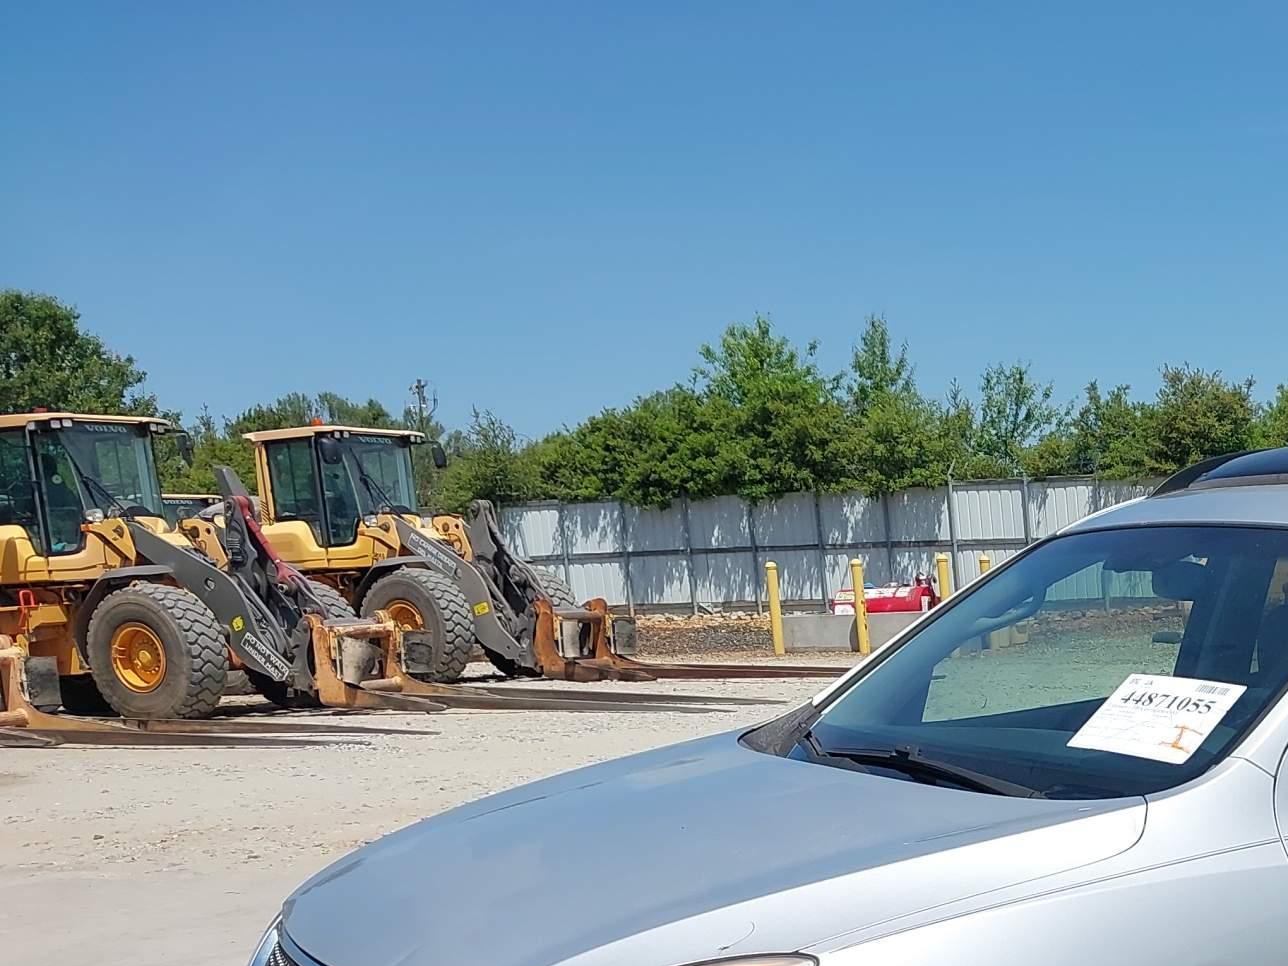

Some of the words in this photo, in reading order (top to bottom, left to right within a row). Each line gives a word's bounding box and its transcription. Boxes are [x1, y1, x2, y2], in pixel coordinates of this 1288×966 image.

[83, 424, 128, 433] VOLVO
[358, 436, 392, 445] VOLVO
[244, 642, 266, 664] UNDER
[265, 662, 283, 679] MAST
[246, 633, 256, 645] DO
[255, 642, 271, 657] NOT
[270, 654, 289, 674] WALK
[1121, 690, 1216, 714] 44871055
